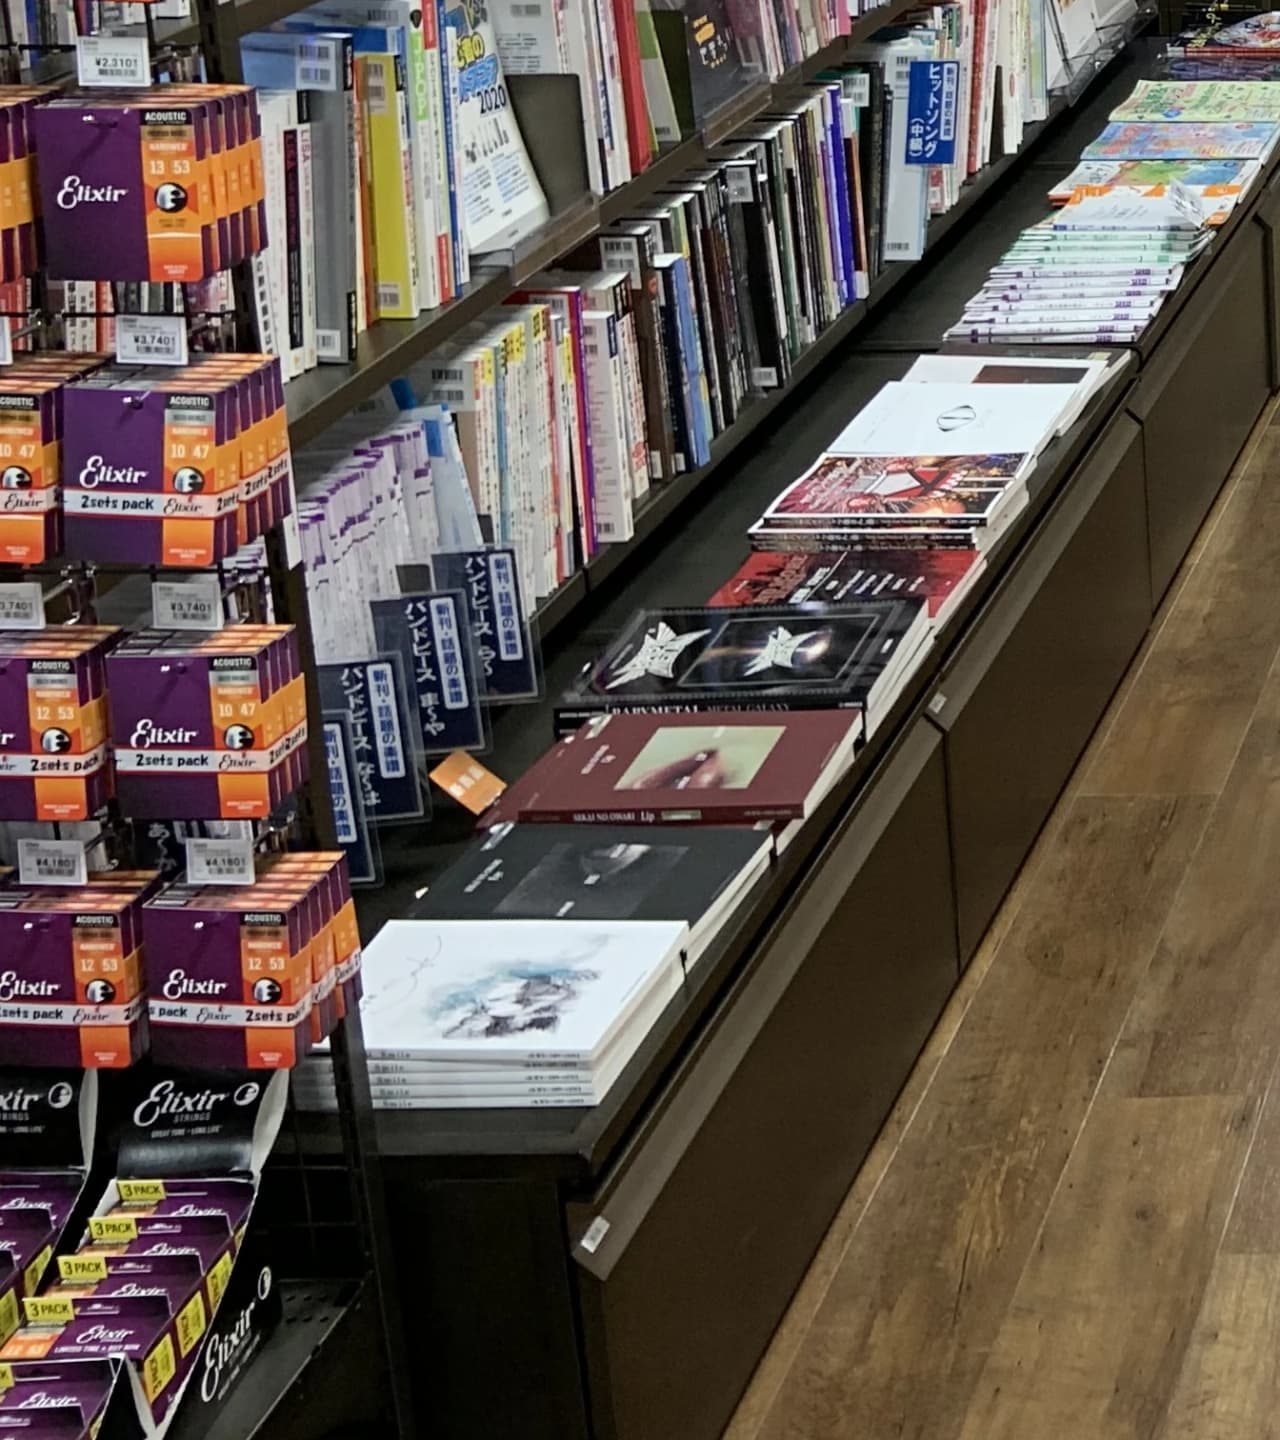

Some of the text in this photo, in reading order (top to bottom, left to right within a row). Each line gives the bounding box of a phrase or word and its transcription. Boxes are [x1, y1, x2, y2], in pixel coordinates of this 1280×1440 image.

[479, 86, 507, 113] 2020
[144, 111, 187, 123] ACOUSTIC
[927, 62, 941, 159] ヒットソング
[149, 159, 190, 175] 13 53
[57, 174, 128, 210] Elixir
[169, 396, 209, 407] ACOUSTIC
[18, 444, 36, 458] 47
[171, 444, 209, 459] 10 47
[79, 455, 147, 489] Elixir
[4, 493, 45, 509] Elixir
[81, 494, 154, 511] 2sets pack
[163, 495, 203, 515] Elixir
[32, 661, 71, 672] ACOUSTIC
[213, 657, 253, 668] ACOUSTIC
[36, 706, 75, 720] 12 53
[218, 702, 257, 717] 10 47
[130, 718, 197, 749] Elixir
[31, 759, 70, 773] 2sets
[136, 753, 209, 770] 2sets pack
[218, 751, 257, 771] Elixir
[640, 810, 655, 823] Lip
[75, 916, 114, 925] ACOUSTIC
[244, 914, 282, 923] ACOUSTIC
[163, 969, 228, 1000] Elixir
[33, 1009, 63, 1021] pack
[158, 1006, 188, 1020] pack
[245, 1009, 283, 1023] 2sets
[133, 1080, 231, 1128] Elixir
[123, 1184, 161, 1197] 3 PACK
[94, 1222, 134, 1235] 3 PACK
[63, 1261, 103, 1275] 3 PACK
[29, 1302, 70, 1316] 3 PACK
[76, 1325, 134, 1344] Elixir
